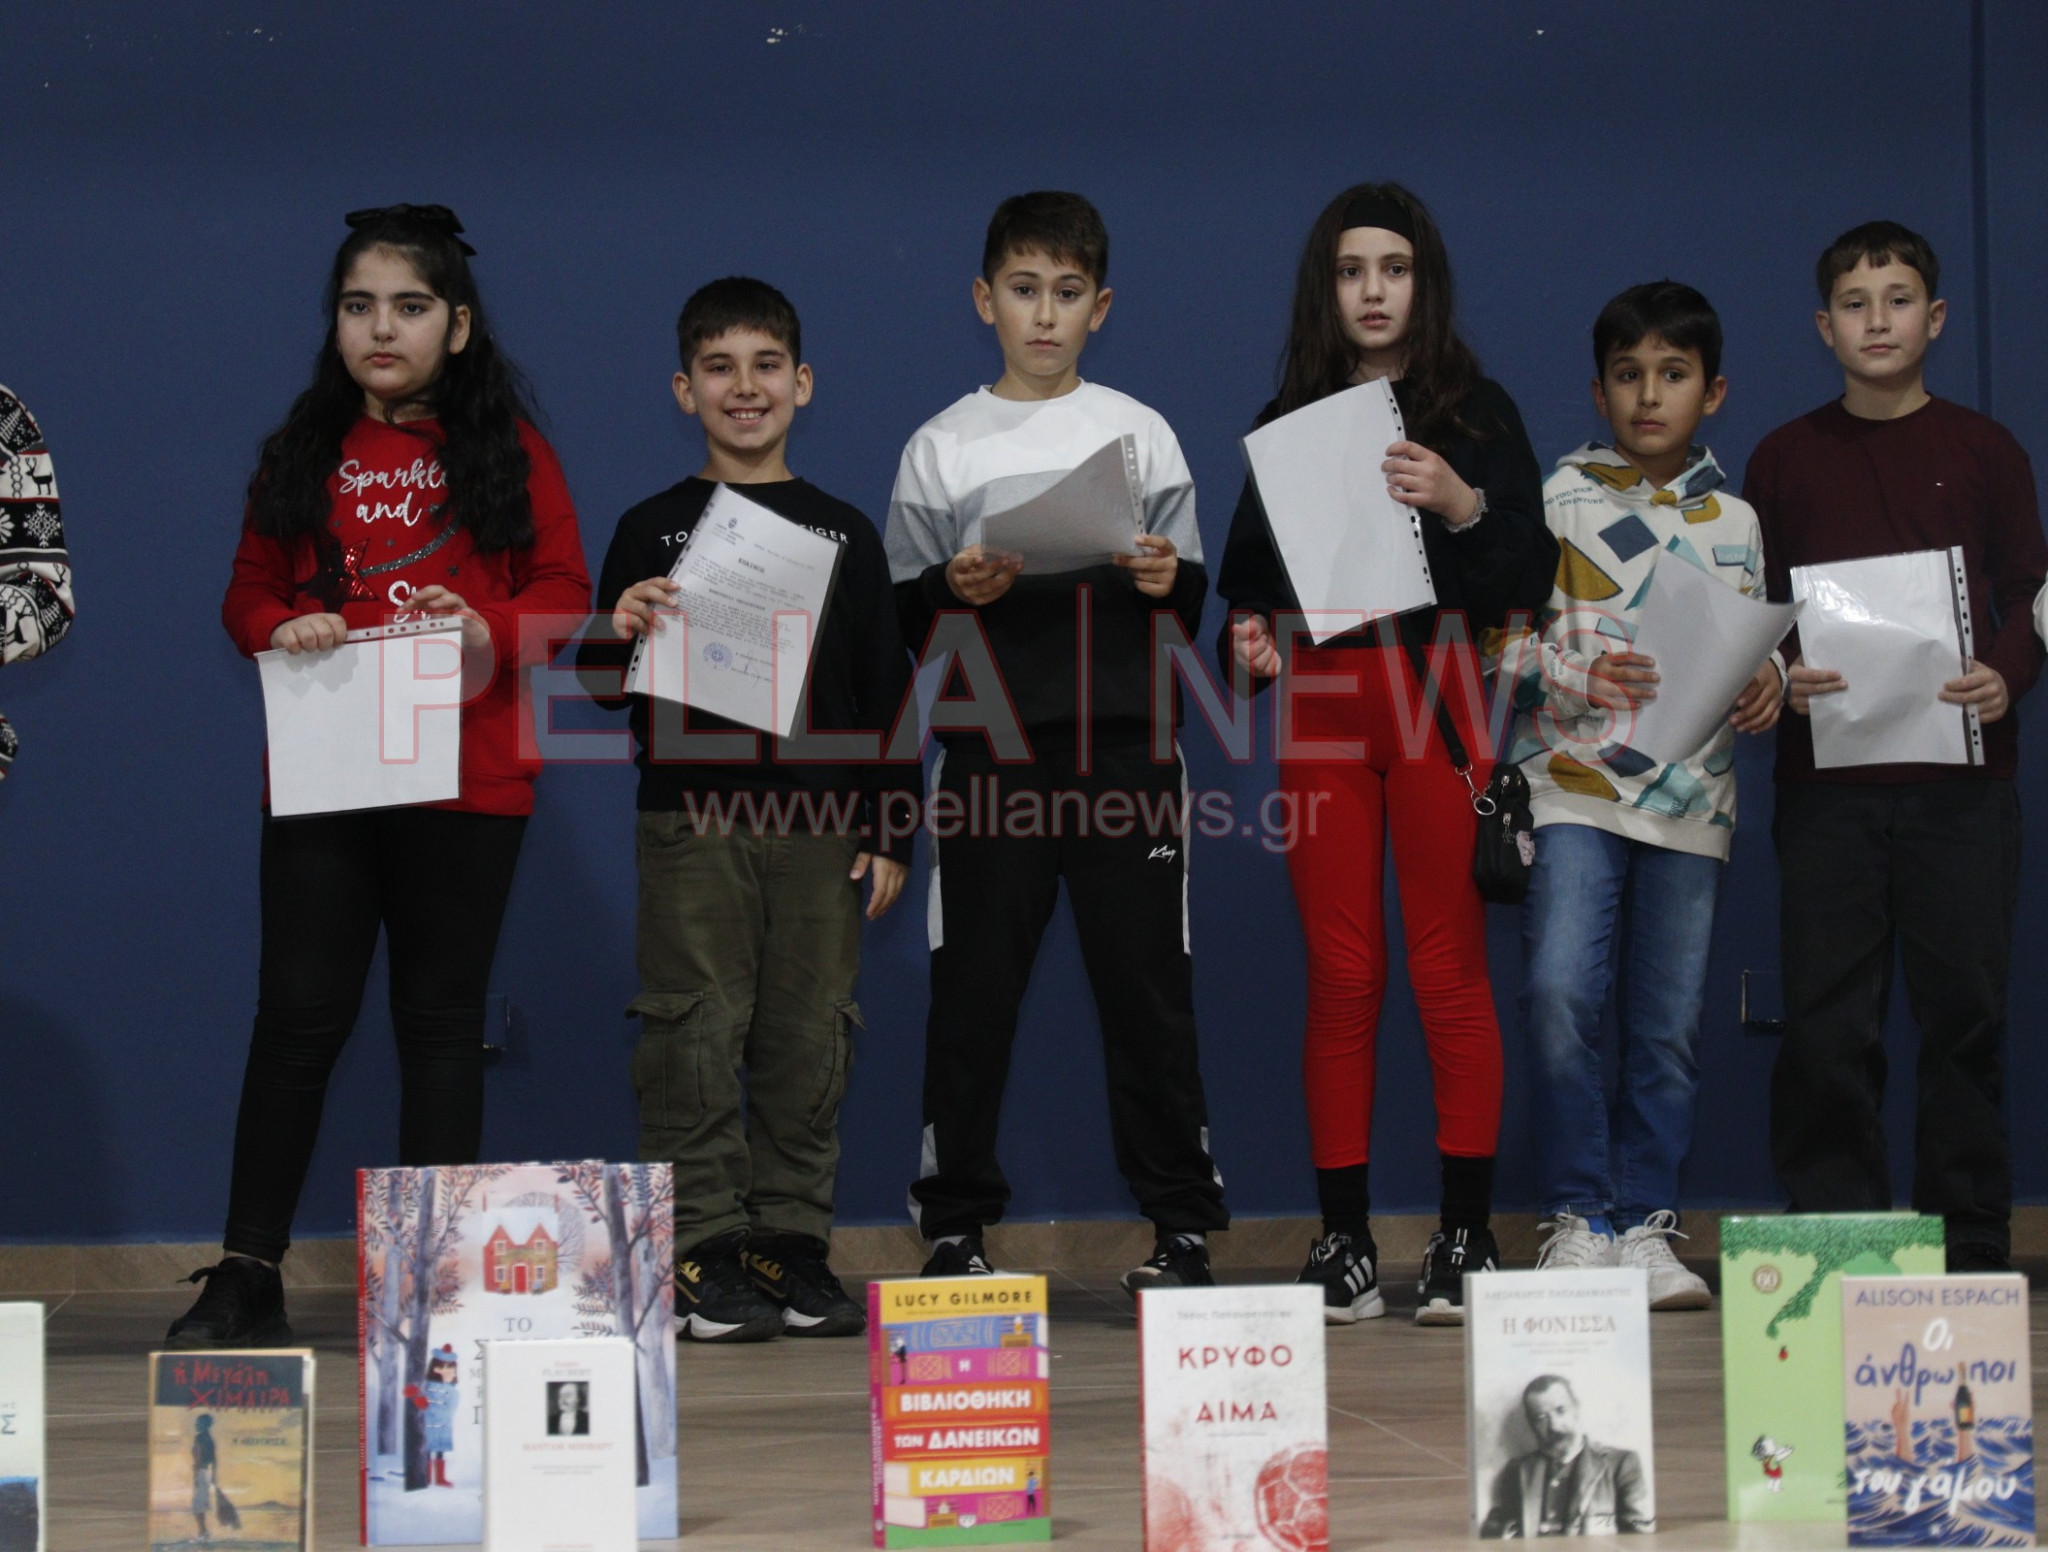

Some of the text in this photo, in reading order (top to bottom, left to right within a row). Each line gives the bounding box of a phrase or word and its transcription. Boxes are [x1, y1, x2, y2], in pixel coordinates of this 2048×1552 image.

[356, 491, 423, 527] and
[1558, 497, 1604, 507] ADVENTURE
[895, 1290, 1032, 1307] LUCY GILMORE
[1856, 1287, 2020, 1306] ALISON ESPACH
[504, 1317, 532, 1333] ΤΟ
[1502, 1314, 1617, 1335] Η ΦΟΝΙΣΣΑ
[959, 1359, 971, 1372] Η
[1178, 1344, 1293, 1369] ΚΡΥΦΟ
[900, 1389, 1032, 1412] ΒΙΒΛΙΟΘΗΚΗ
[1196, 1400, 1278, 1423] ΑΙΜΑ
[927, 1427, 1040, 1450] ΔΑΝΕΙΚΩΝ
[919, 1467, 1015, 1489] ΚΑΡΔΙΩΝ
